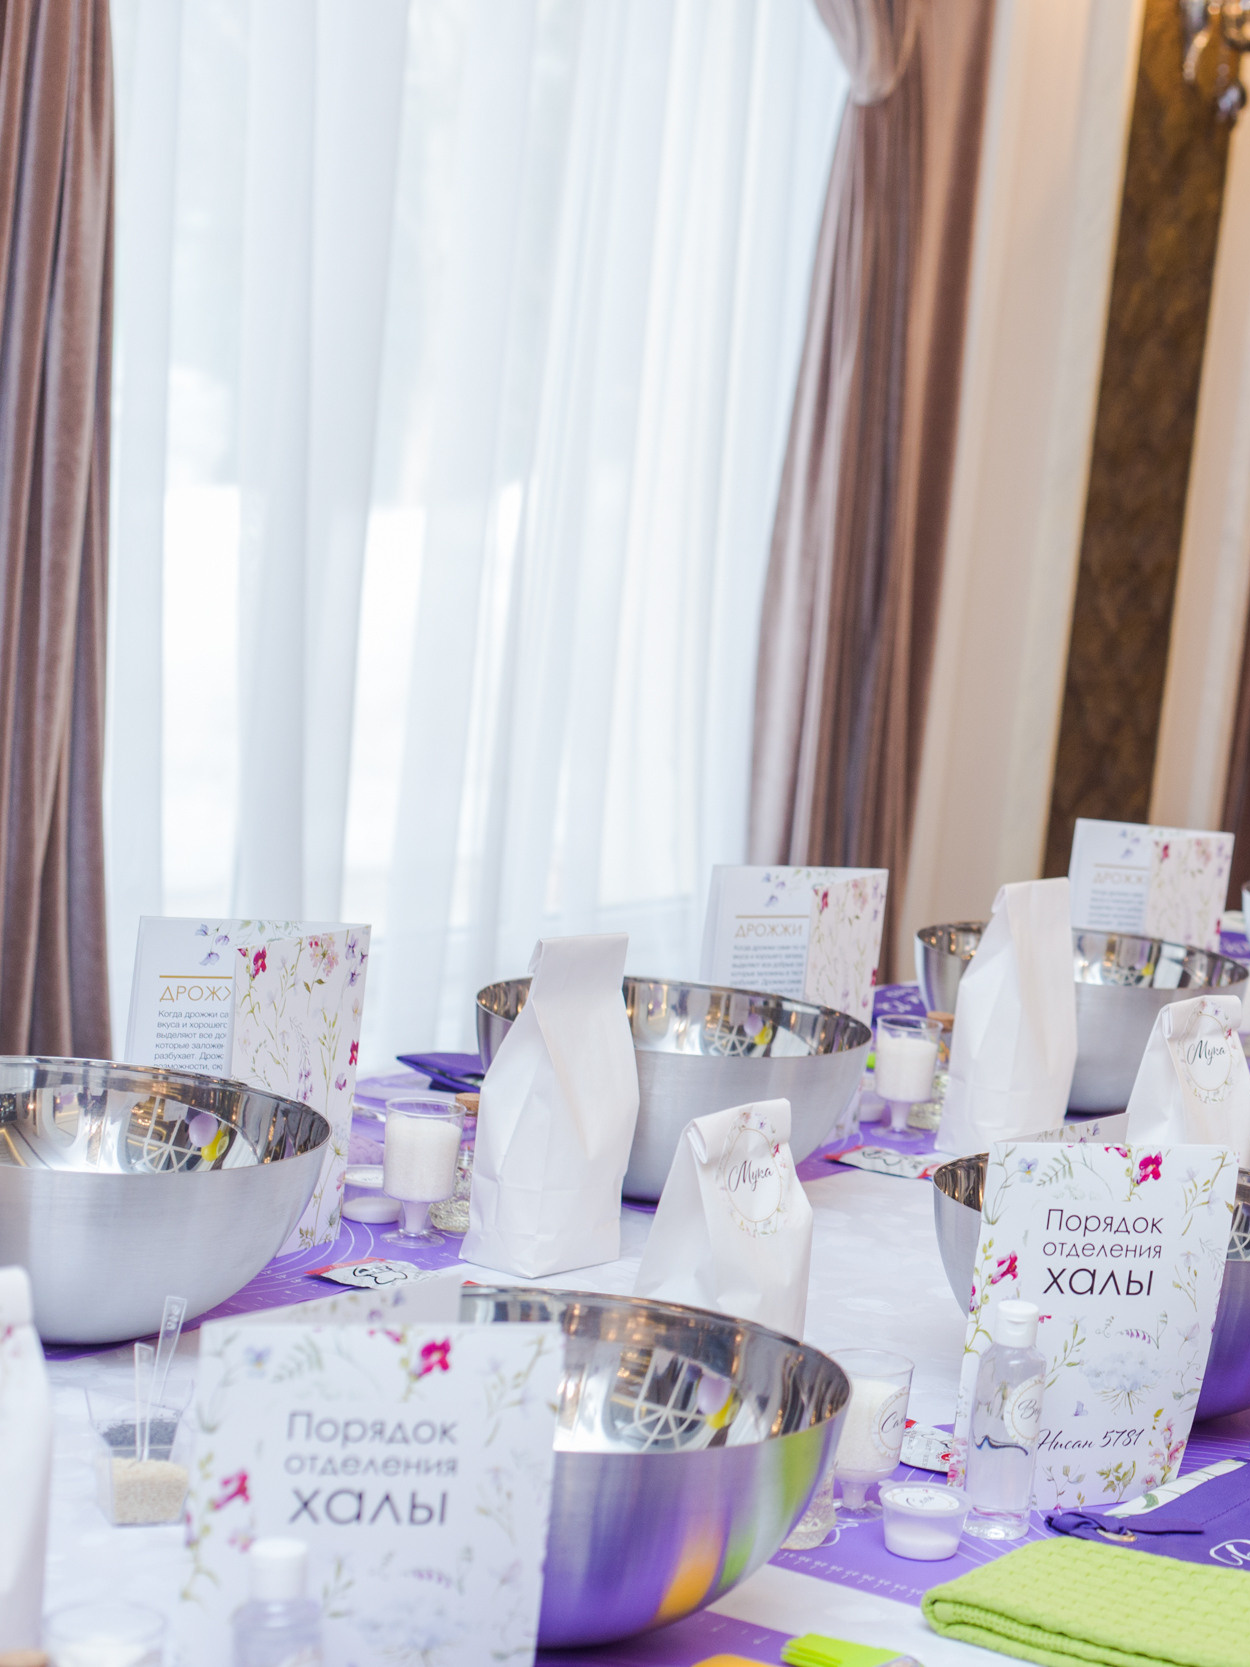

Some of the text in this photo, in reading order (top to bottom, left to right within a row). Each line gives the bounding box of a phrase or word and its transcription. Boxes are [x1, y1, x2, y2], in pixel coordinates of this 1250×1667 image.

[734, 923, 803, 938] ДРОЖЖИ
[157, 1021, 180, 1030] вкуса
[158, 1010, 182, 1018] Когда
[184, 1010, 218, 1020] дрожжи
[1187, 1040, 1225, 1066] Мука
[728, 1160, 774, 1192] Мука
[1046, 1208, 1164, 1237] Порядок
[1043, 1241, 1162, 1259] отделения
[1042, 1267, 1153, 1296] халы
[287, 1410, 458, 1449] Порядок
[1038, 1429, 1145, 1451] Нисан 5781
[284, 1453, 459, 1477] отделения
[288, 1487, 448, 1526] халы
